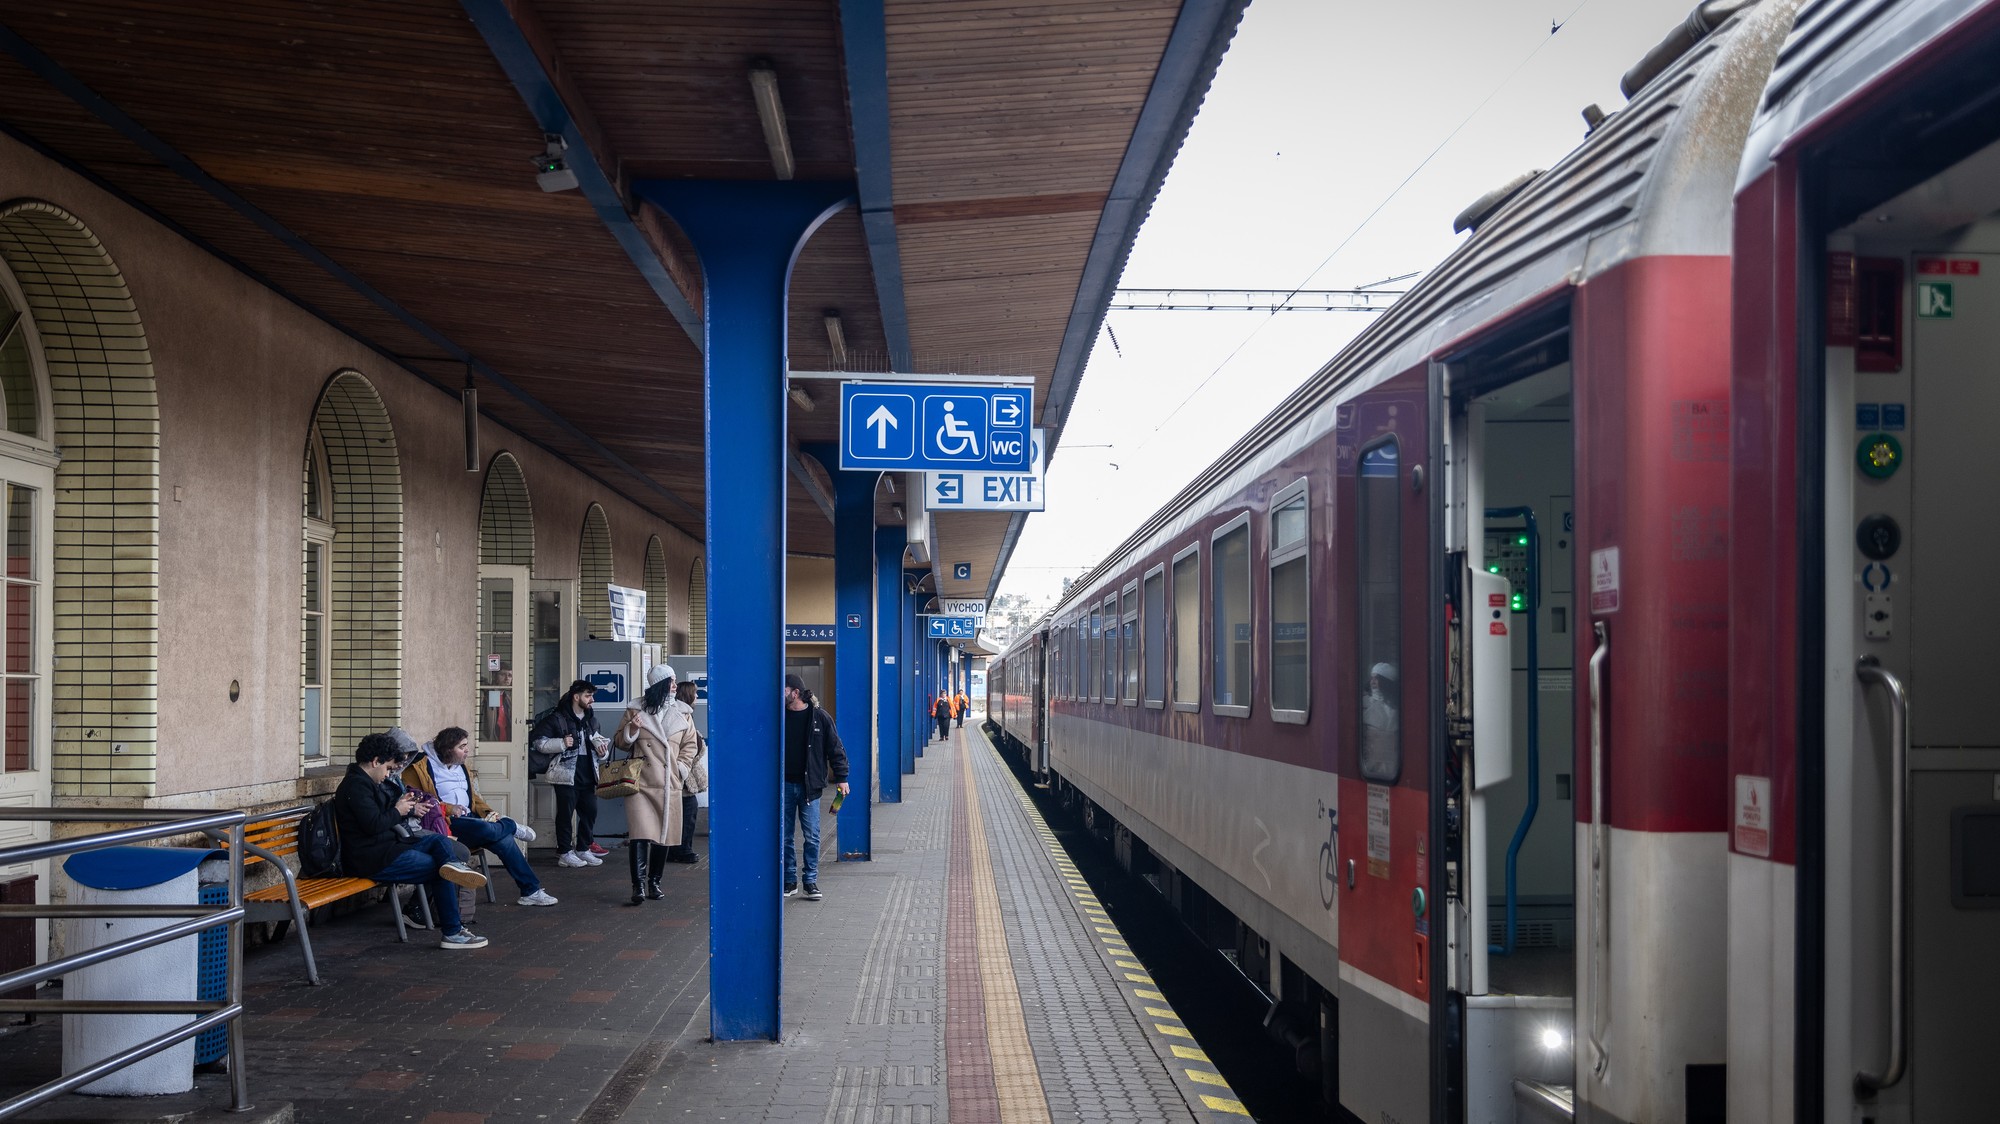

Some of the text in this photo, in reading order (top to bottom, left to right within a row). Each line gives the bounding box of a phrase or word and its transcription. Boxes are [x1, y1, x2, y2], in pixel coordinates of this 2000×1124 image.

[992, 440, 1021, 455] WC
[984, 477, 1036, 502] EXIT
[957, 566, 967, 577] C
[947, 601, 984, 612] VÝCHOD
[975, 617, 983, 625] IT
